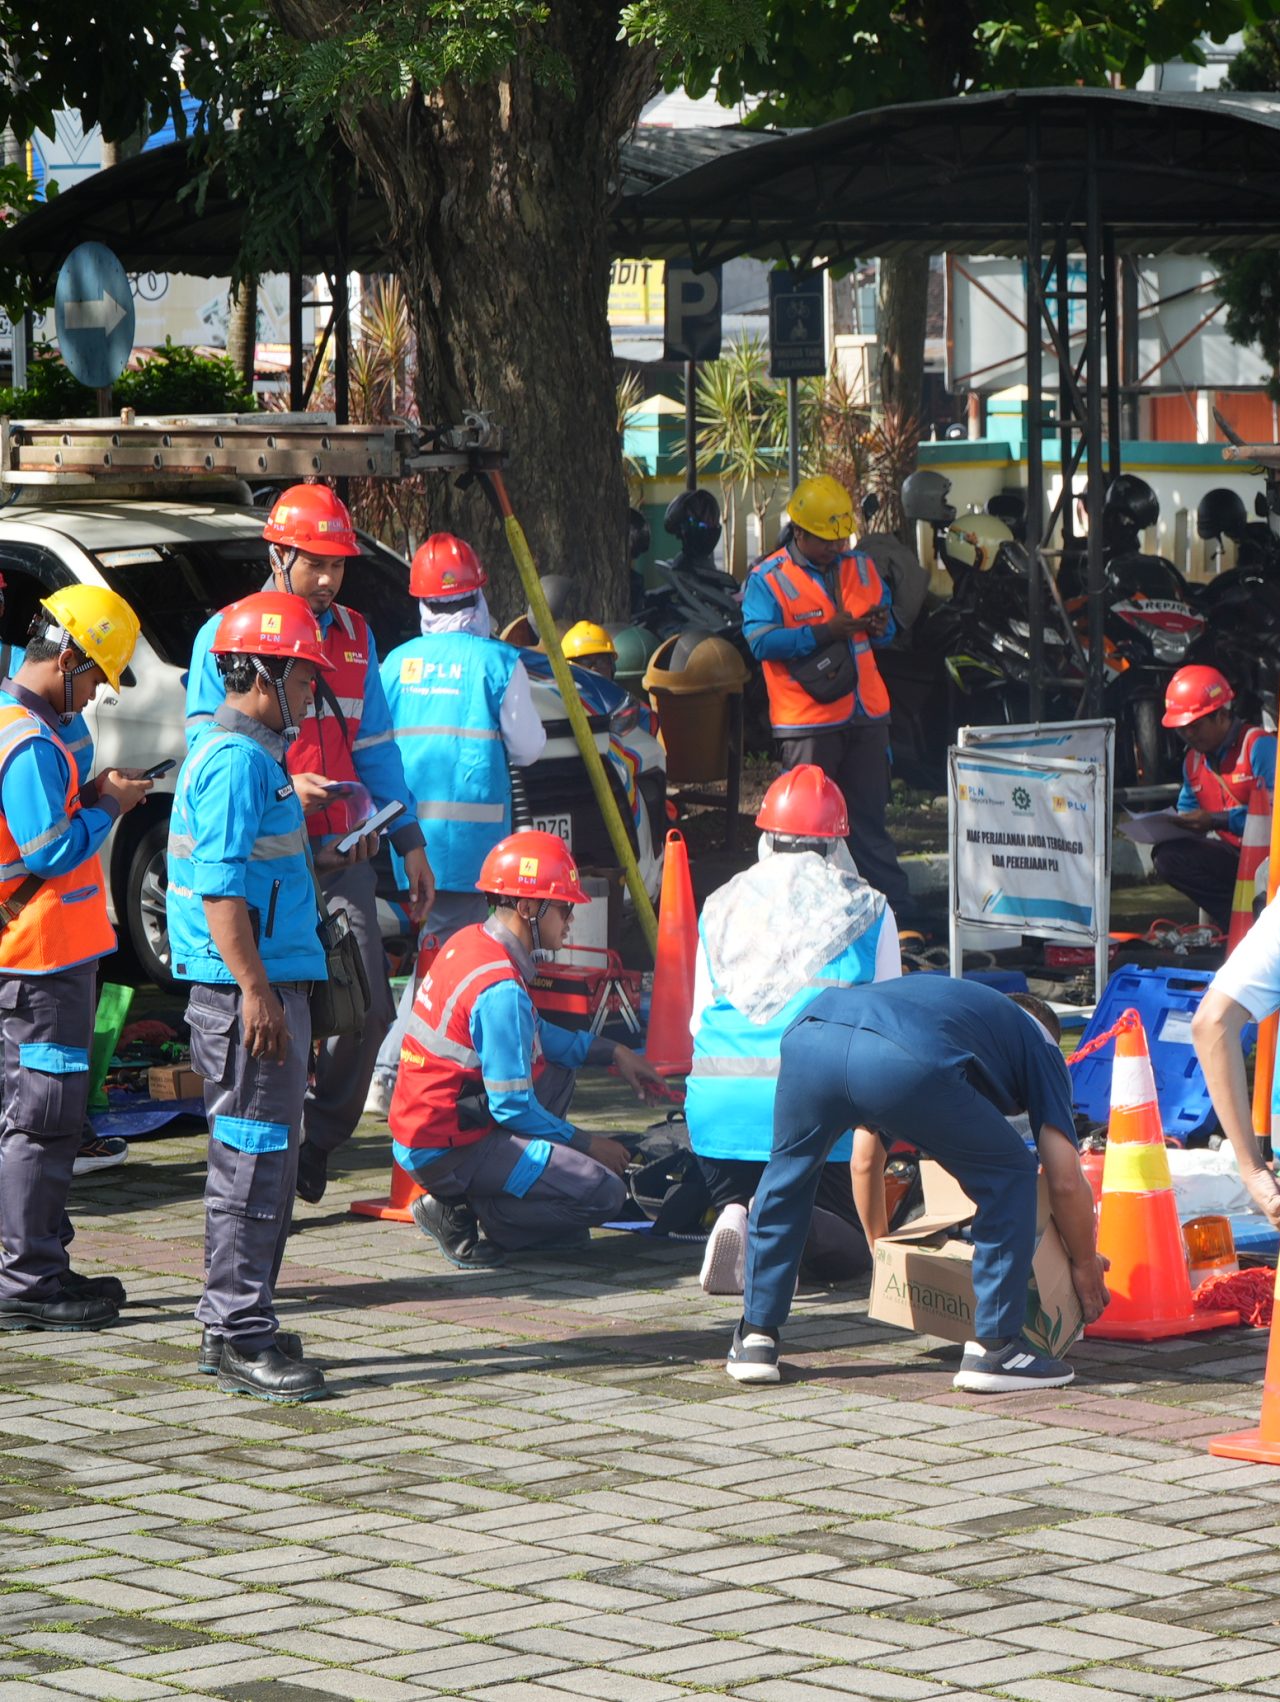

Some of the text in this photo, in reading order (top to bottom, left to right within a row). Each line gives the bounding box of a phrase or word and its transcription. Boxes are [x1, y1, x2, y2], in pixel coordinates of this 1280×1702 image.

[668, 268, 719, 348] P
[260, 634, 281, 643] PLN
[423, 662, 462, 680] PLN
[968, 786, 984, 796] PLN
[981, 831, 1026, 847] PERJALANAN
[1027, 834, 1046, 848] ANDA
[1006, 856, 1048, 871] PEKERJAAN
[518, 876, 537, 885] PLN
[884, 1272, 971, 1319] Amanah
